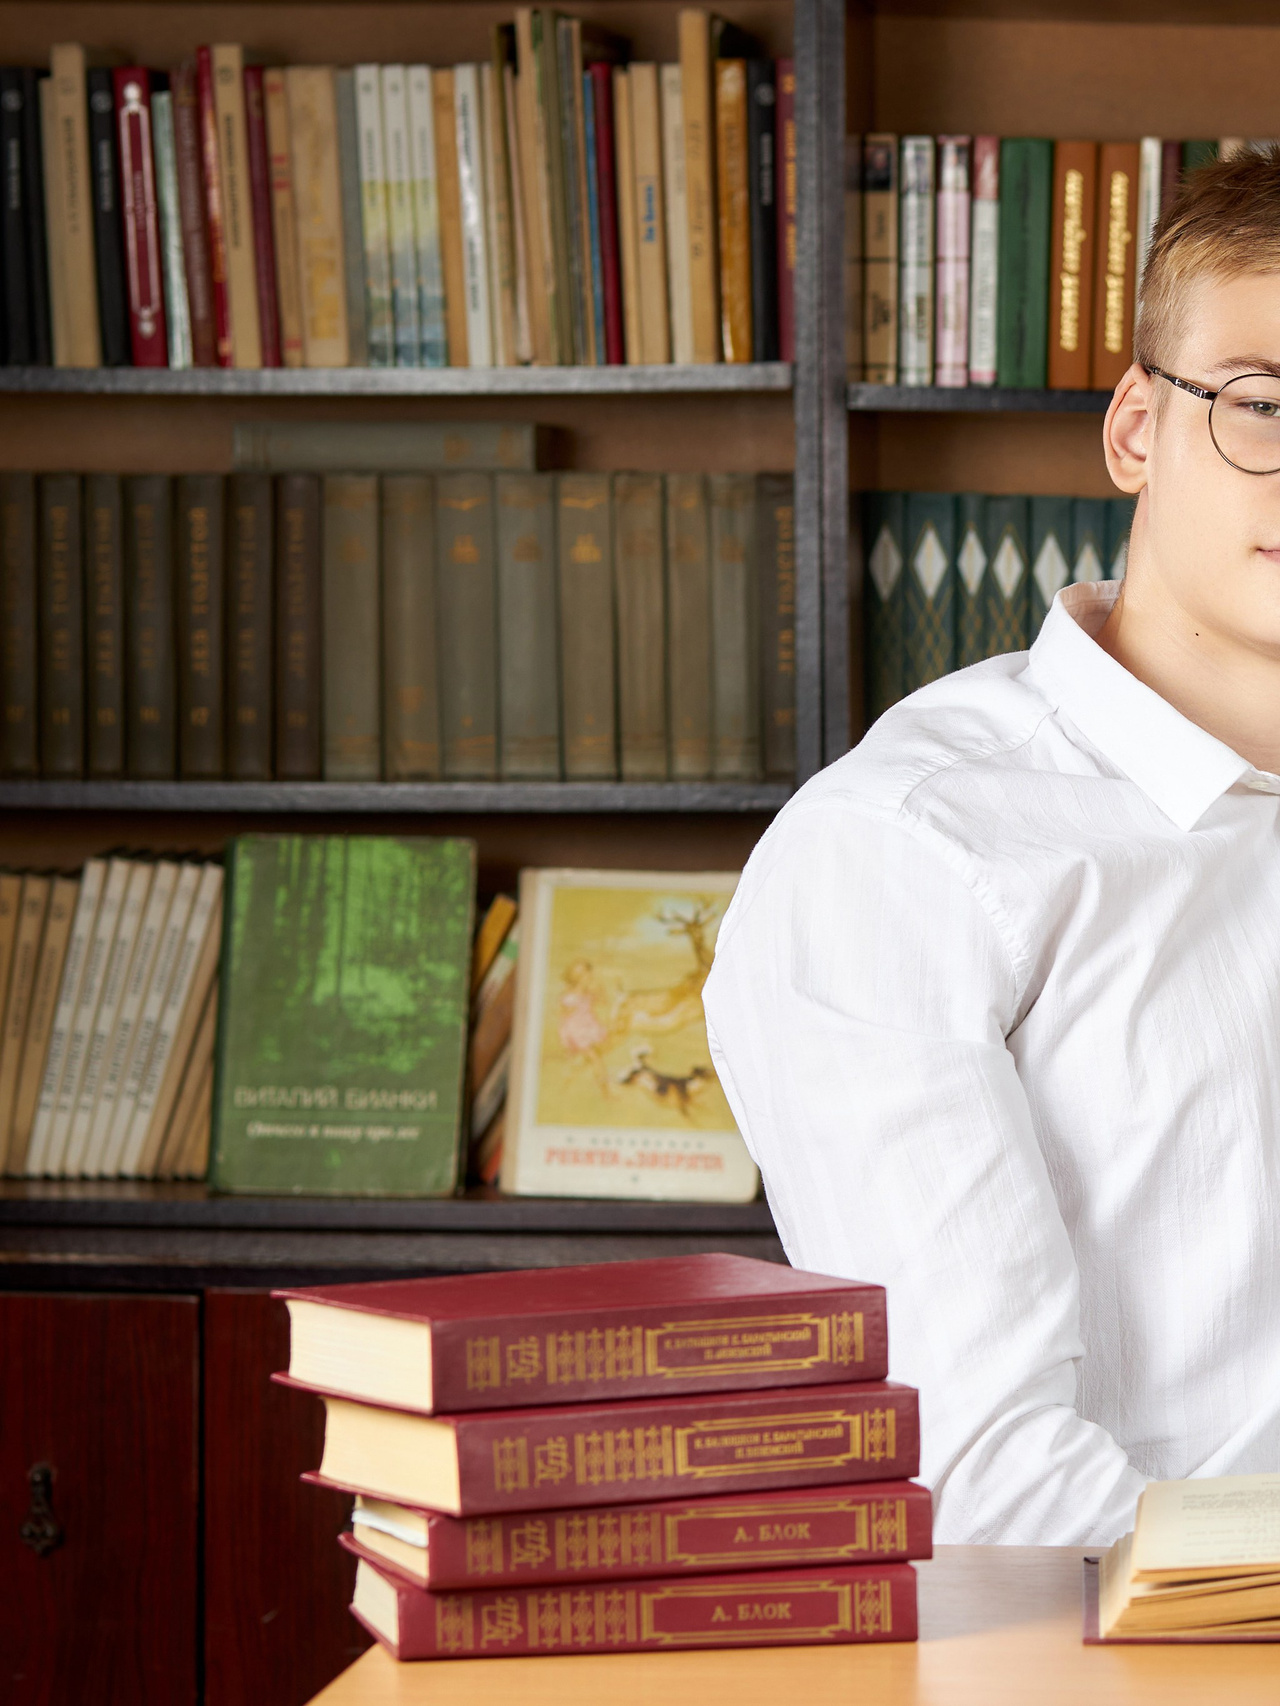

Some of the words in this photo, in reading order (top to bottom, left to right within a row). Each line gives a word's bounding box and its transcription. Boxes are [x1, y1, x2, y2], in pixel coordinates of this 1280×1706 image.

[234, 1085, 339, 1109] ВИТАЛИЙ
[345, 1088, 437, 1110] БИАНКИ
[733, 1526, 753, 1543] А.
[759, 1522, 811, 1541] БЛОК
[711, 1605, 732, 1622] А.
[737, 1602, 791, 1620] БЛОК
